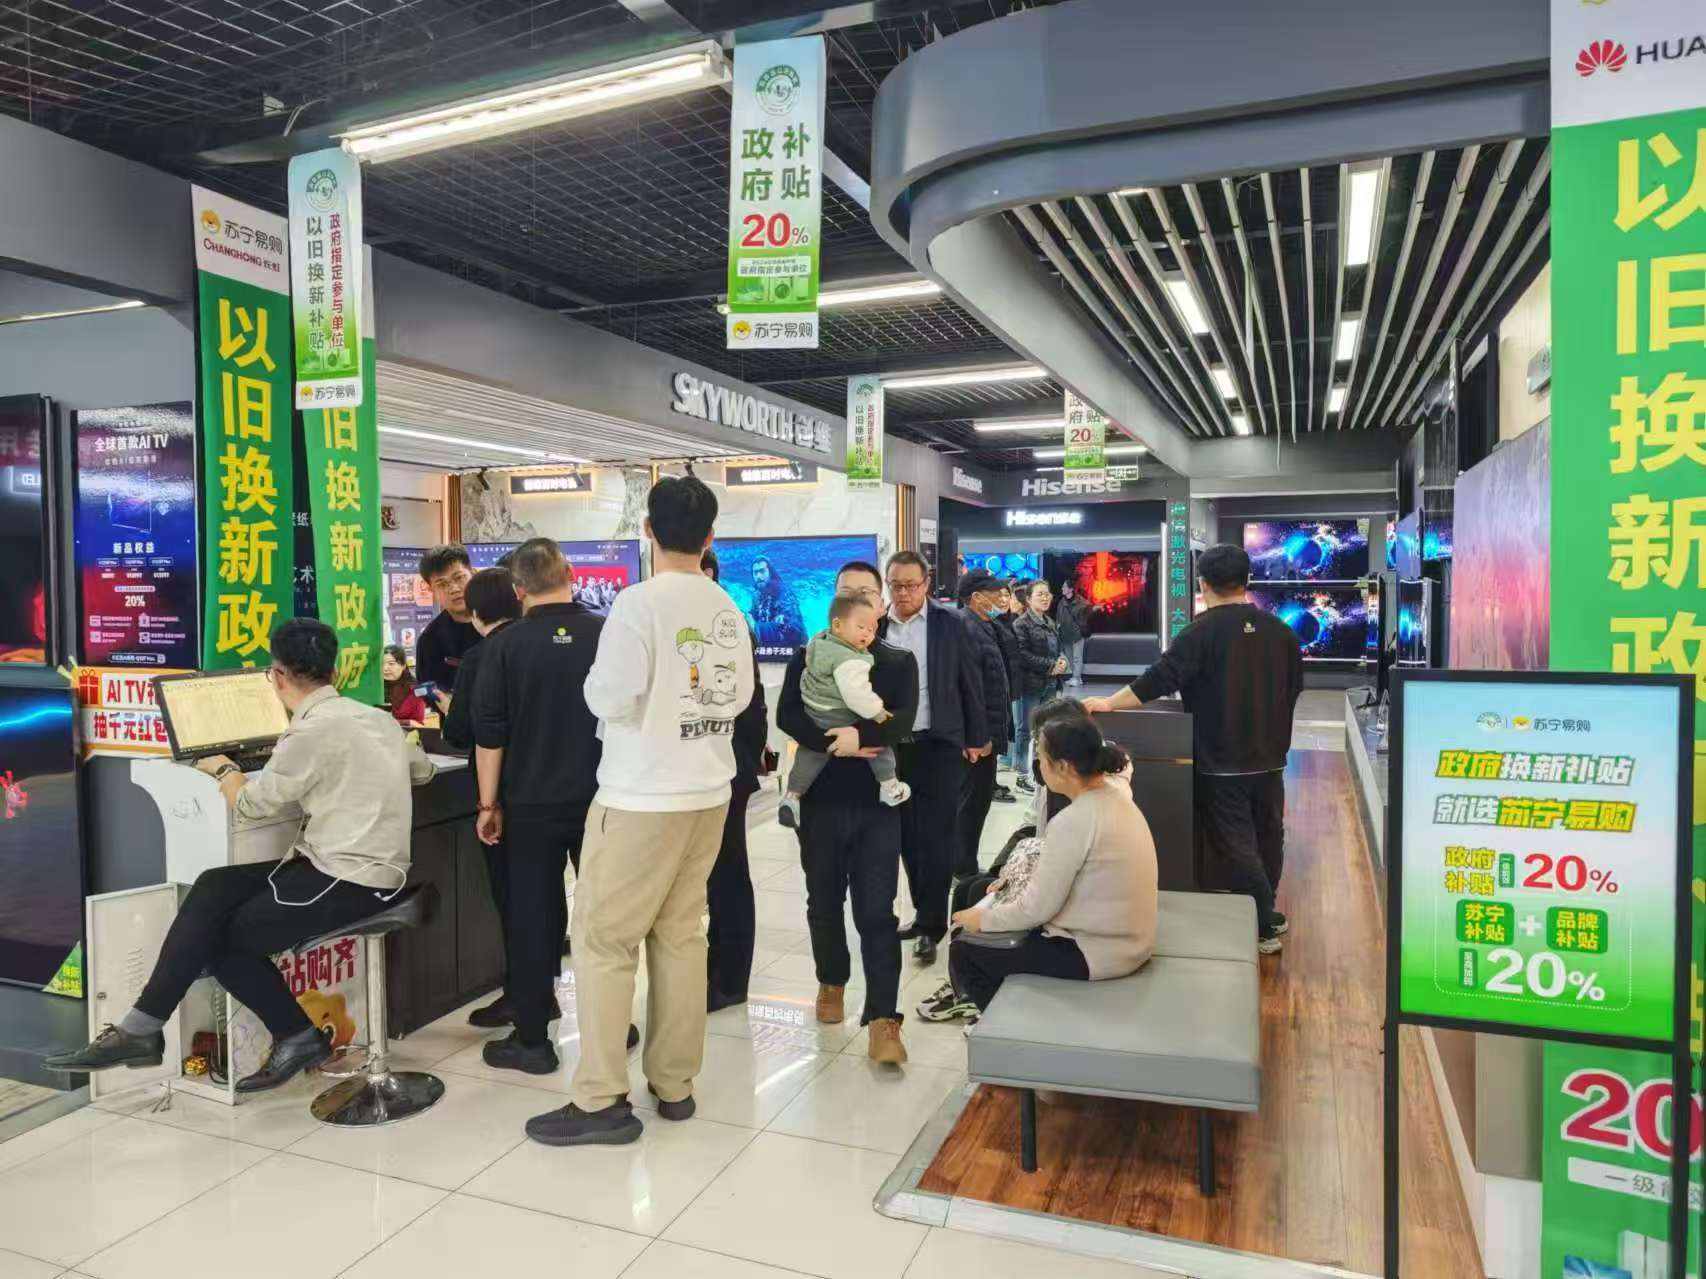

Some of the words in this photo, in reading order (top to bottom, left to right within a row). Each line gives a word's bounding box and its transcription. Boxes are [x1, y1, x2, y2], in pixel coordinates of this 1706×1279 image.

[741, 127, 774, 201] 政府
[781, 123, 811, 200] 补贴
[224, 220, 284, 256] 苏宁易购
[741, 212, 809, 248] 20%
[203, 238, 262, 267] CHANGHONG
[306, 217, 325, 350] 以旧换新补贴
[329, 213, 346, 349] 政府指定参与单位
[754, 322, 813, 338] 苏宁易购
[314, 385, 357, 400] 苏宁易购
[671, 372, 794, 444] SKYWORTH
[153, 433, 169, 449] TV
[216, 298, 279, 668] 以旧换新政
[1022, 477, 1121, 497] Hisense
[1006, 511, 1082, 527] Hisense
[1533, 718, 1591, 732] 苏宁易购
[1435, 750, 1636, 786] 政府换新补贴
[1433, 794, 1638, 832] 就选苏宁易购
[1444, 846, 1496, 870] 政府
[1444, 871, 1496, 896] 补贴
[1522, 853, 1619, 893] 20%
[1465, 903, 1505, 923] 苏宁
[1556, 911, 1599, 930] 品牌
[1465, 922, 1505, 943] 补贴
[1556, 930, 1599, 950] 补贴
[1485, 948, 1606, 1001] 20%
